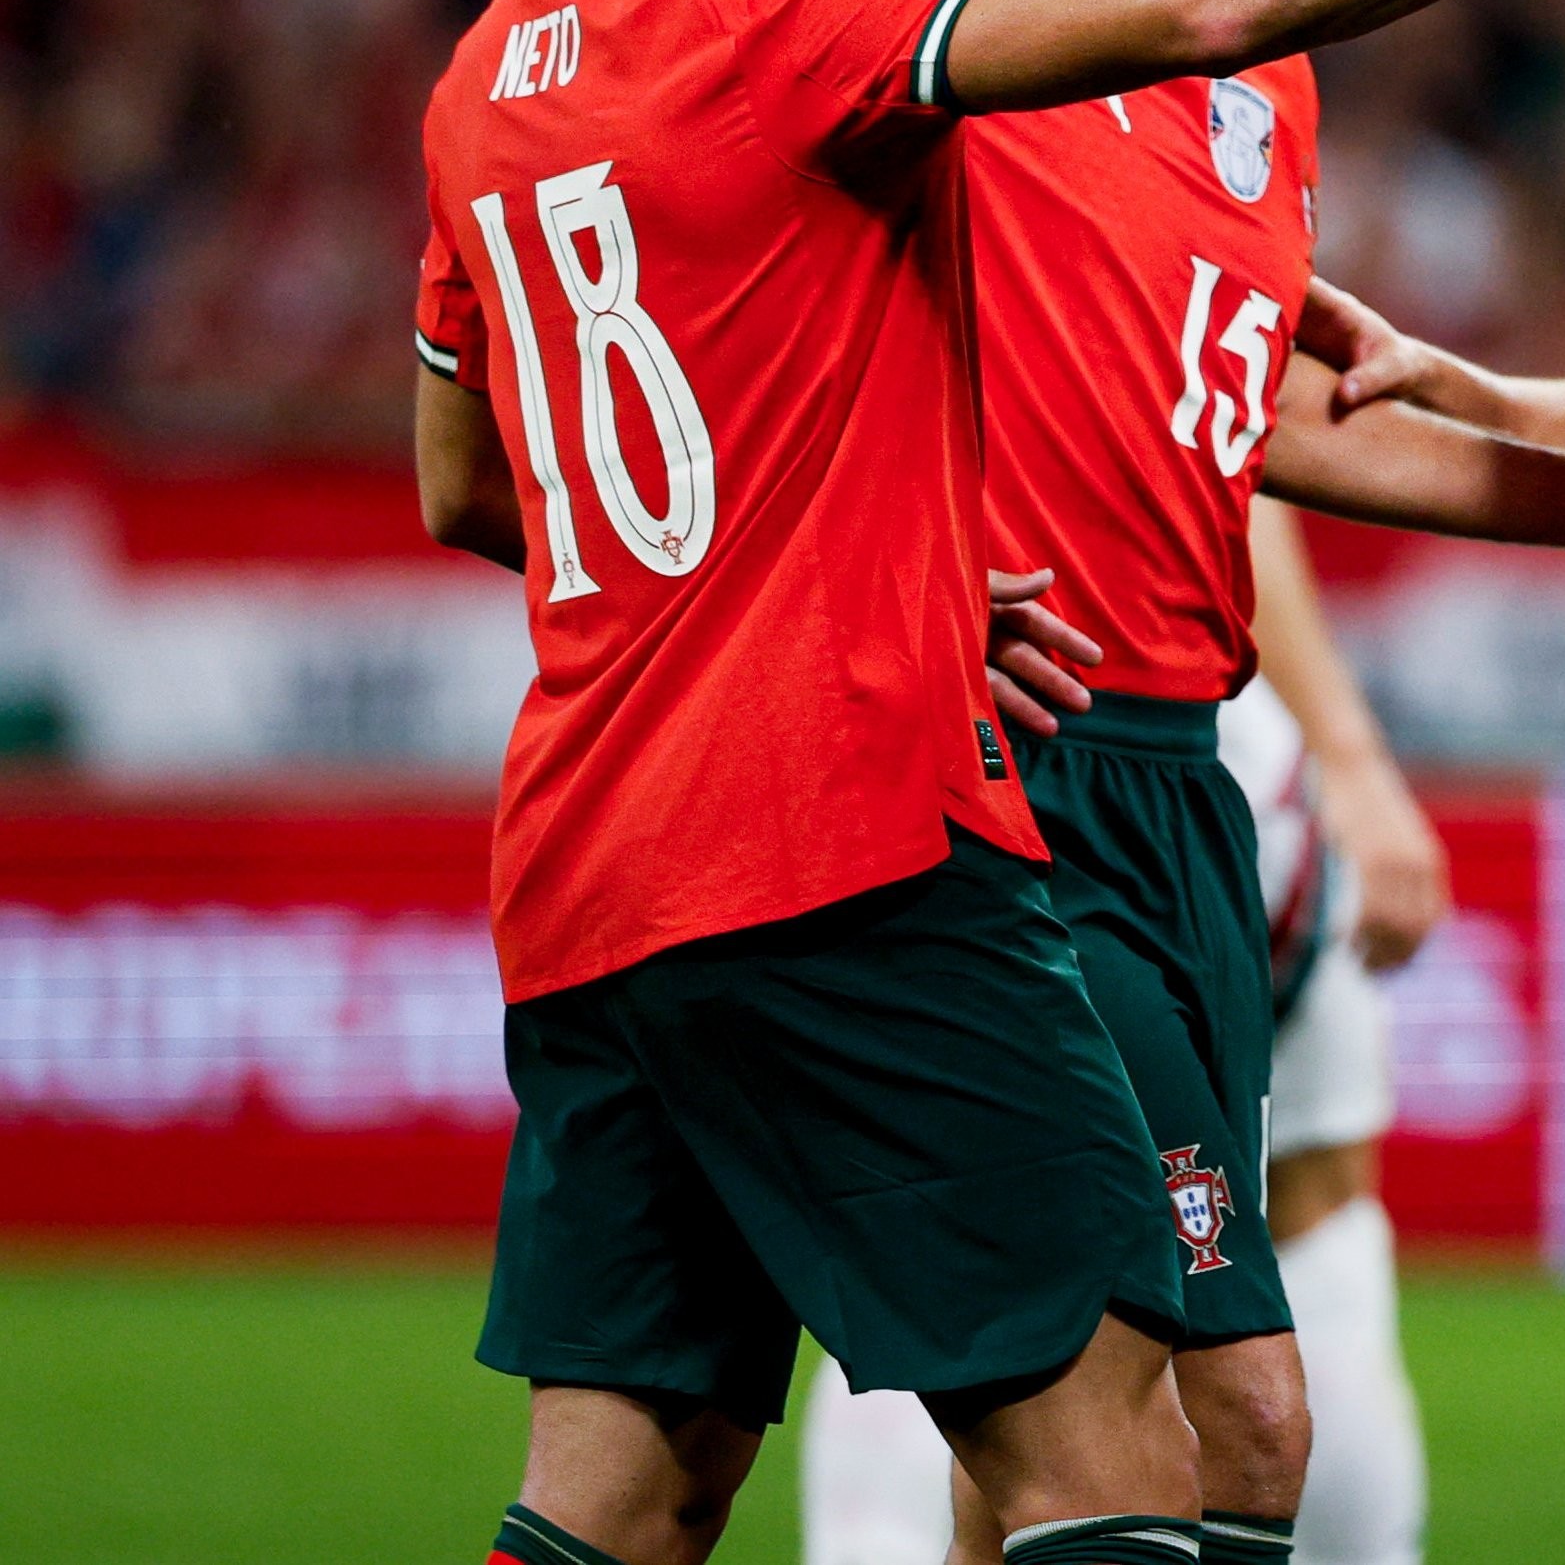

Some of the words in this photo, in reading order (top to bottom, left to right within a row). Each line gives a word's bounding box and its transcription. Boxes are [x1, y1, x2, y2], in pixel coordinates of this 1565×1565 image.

[488, 4, 582, 102] NETO
[471, 160, 716, 604] 18
[1170, 255, 1282, 477] 15
